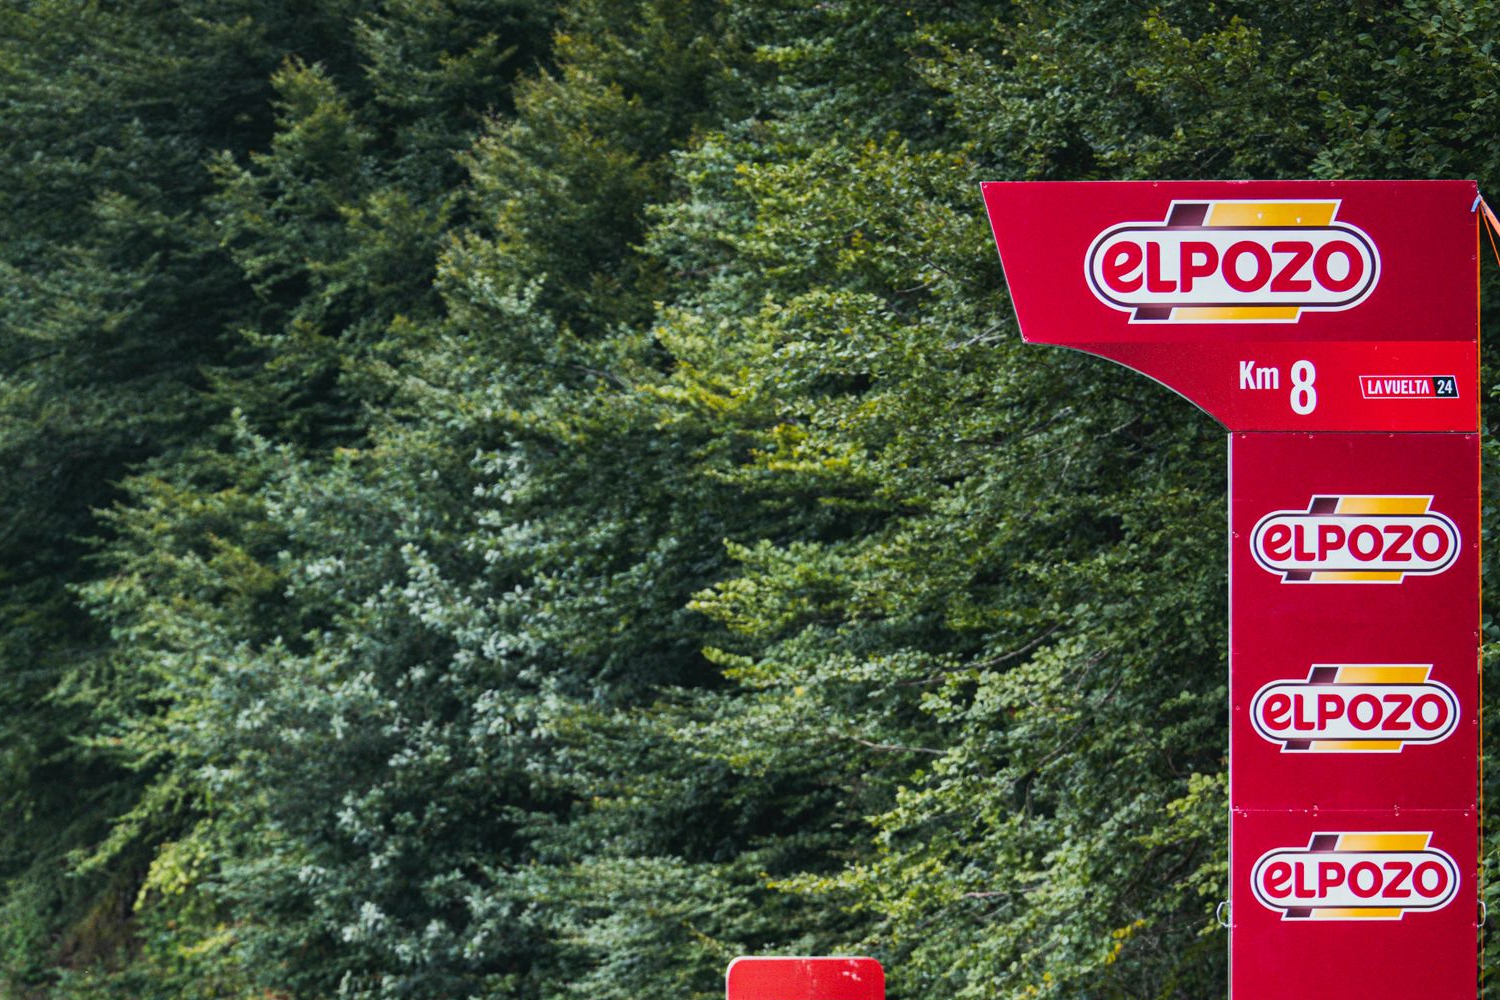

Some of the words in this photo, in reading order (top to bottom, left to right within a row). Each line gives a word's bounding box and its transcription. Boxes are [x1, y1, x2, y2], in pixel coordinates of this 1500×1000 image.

[1239, 361, 1279, 390] Km
[1290, 360, 1317, 415] 8
[1367, 380, 1382, 394] LA
[1384, 380, 1430, 394] VUELTA
[1437, 379, 1453, 394] 24
